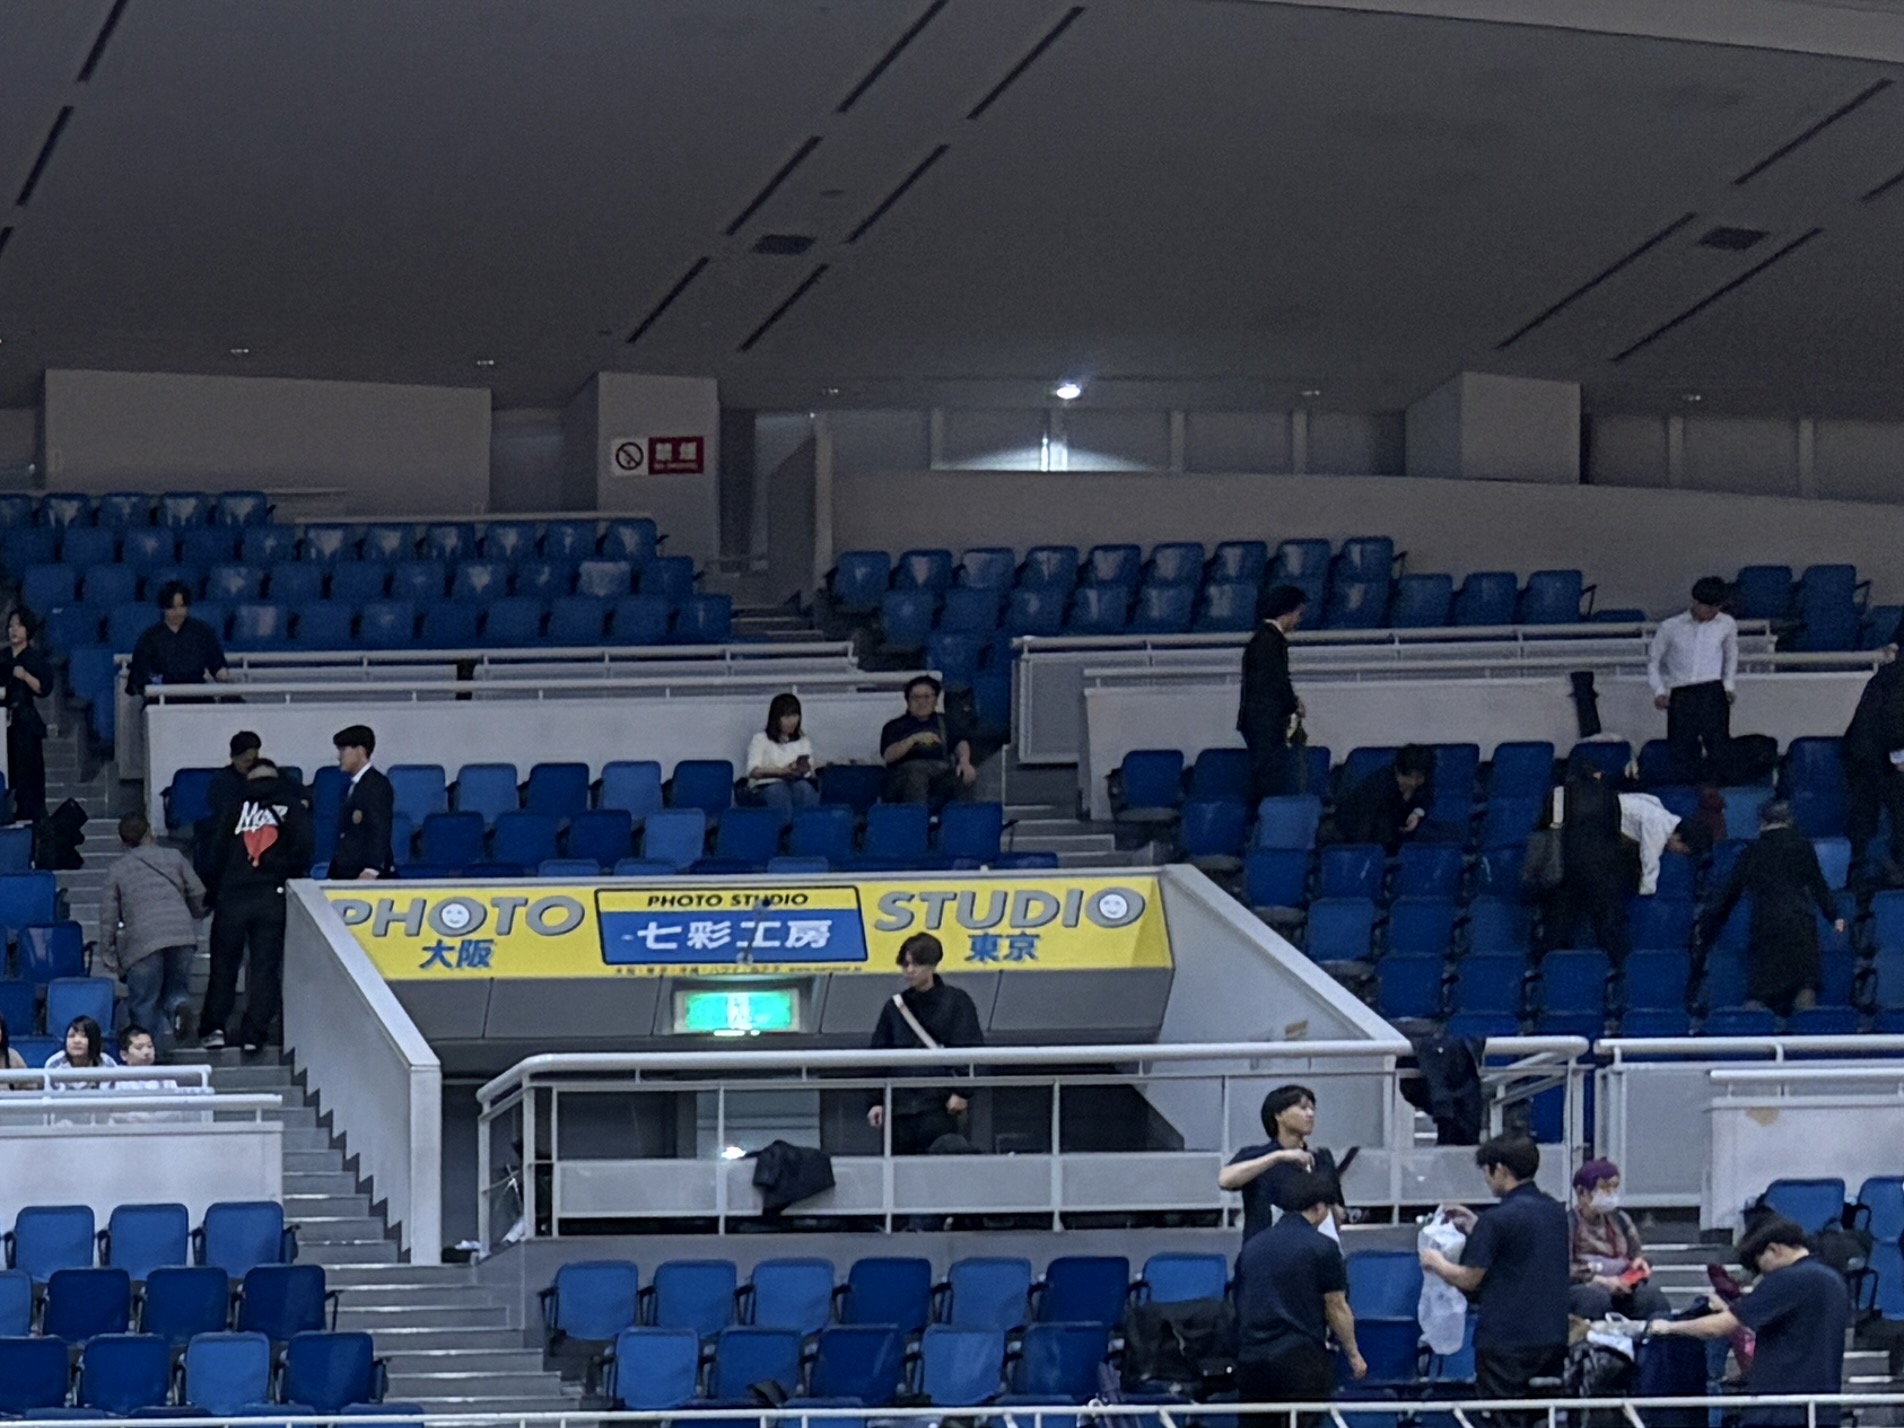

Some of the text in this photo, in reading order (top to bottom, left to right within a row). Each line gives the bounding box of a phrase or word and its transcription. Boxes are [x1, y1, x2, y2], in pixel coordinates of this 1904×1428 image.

[647, 894, 723, 908] PHOTO
[874, 887, 1146, 932] STUDIO
[637, 920, 833, 949] 七彩工房
[963, 932, 1042, 963] 東京
[419, 939, 494, 970] 大阪
